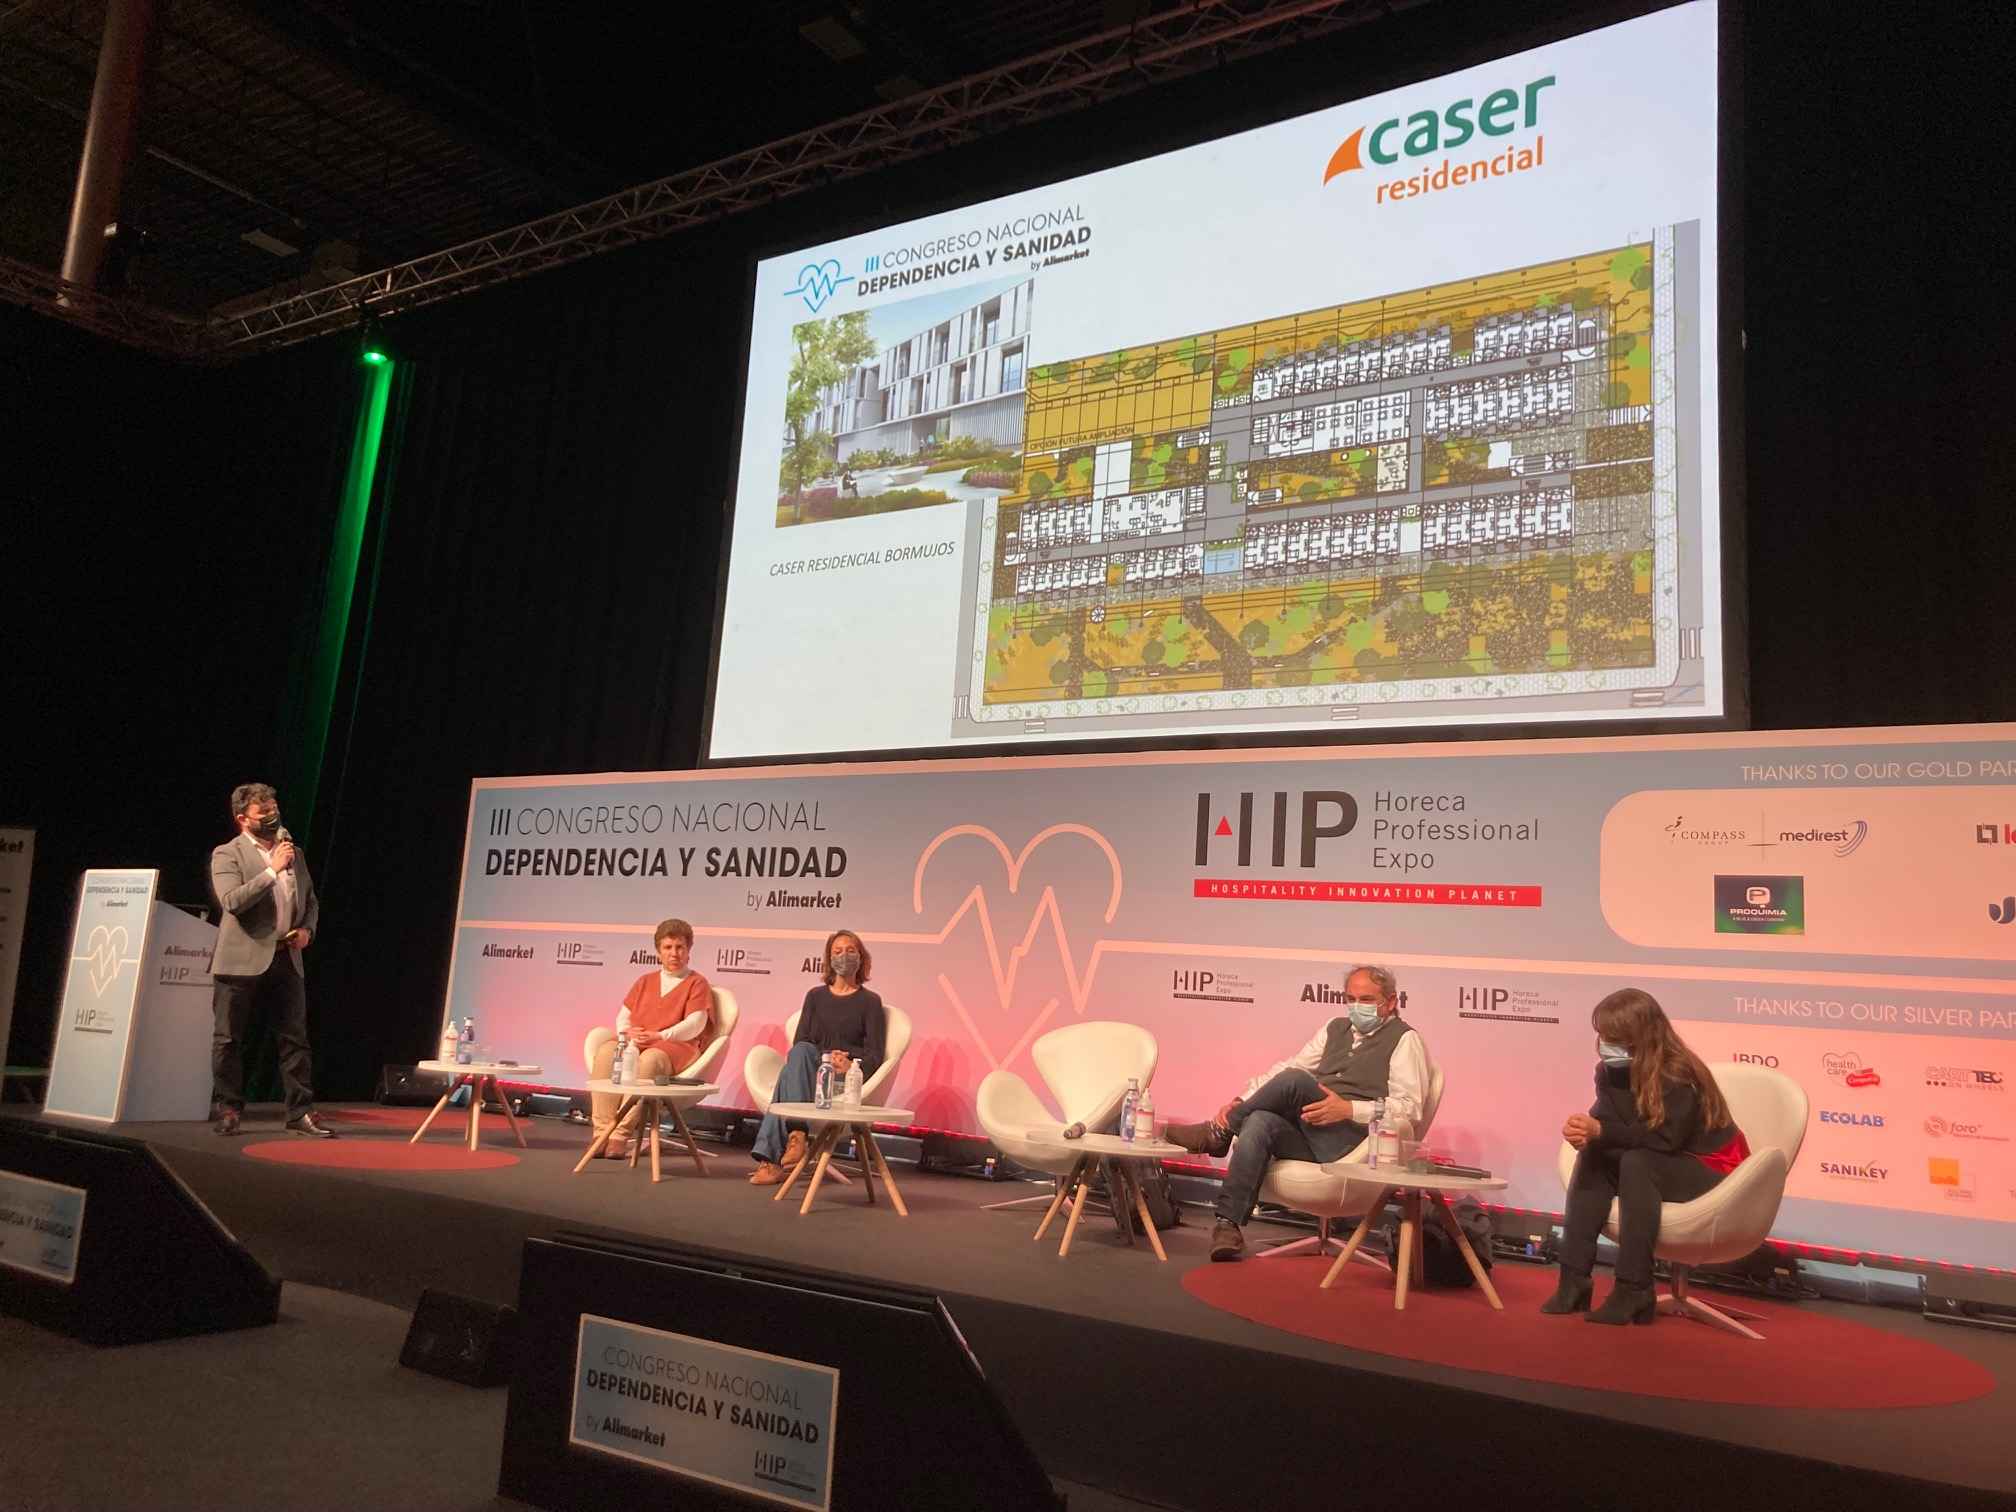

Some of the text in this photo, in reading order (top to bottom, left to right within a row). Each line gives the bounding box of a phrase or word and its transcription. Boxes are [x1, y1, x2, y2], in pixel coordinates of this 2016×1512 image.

[1368, 75, 1556, 166] caser
[1377, 135, 1544, 204] residencial
[864, 203, 1084, 273] III CONGRESO NACIONAL
[858, 226, 1092, 297] DEPENDENCIA Y SANIDAD
[1030, 248, 1090, 272] by Alimarket
[769, 541, 956, 577] CASER RESIDENCIAL BORMUJOS
[1741, 765, 1817, 782] THANKS
[1824, 764, 1848, 780] TO
[1855, 763, 1901, 780] OUR
[1907, 761, 1972, 778] GOLD
[1374, 791, 1466, 812] Horeca
[489, 799, 827, 836] III CONGRESO NACIONAL
[1194, 790, 1359, 867] HIP
[1373, 818, 1539, 841] Professional
[1681, 830, 1746, 840] COMPASS
[1779, 828, 1849, 842] medirest
[485, 845, 848, 878] DEPENDENCIA Y SANIDAD
[1373, 848, 1435, 873] Expo
[746, 889, 842, 911] by Alimarket
[1211, 883, 1519, 902] HOSPITALITY INNOVATION PLANET
[482, 943, 534, 959] Alimarket
[557, 942, 582, 959] HIP
[717, 949, 745, 966] HIP
[1173, 970, 1214, 992] HIP
[1459, 986, 1509, 1011] HIP
[1733, 997, 1813, 1017] THANKS
[1815, 1001, 1845, 1019] TO
[1850, 1002, 1898, 1023] OUR
[1903, 1006, 1974, 1028] SILVER
[1826, 1059, 1857, 1069] health
[1820, 1110, 1884, 1127] ECOLAB
[1820, 1162, 1888, 1180] SANIKEY
[602, 1346, 802, 1411] CONGRESO NACIONAL
[587, 1368, 819, 1445] DEPENDENCIA Y SANIDAD
[602, 1415, 667, 1448] Alimarket
[754, 1449, 787, 1475] HIP
